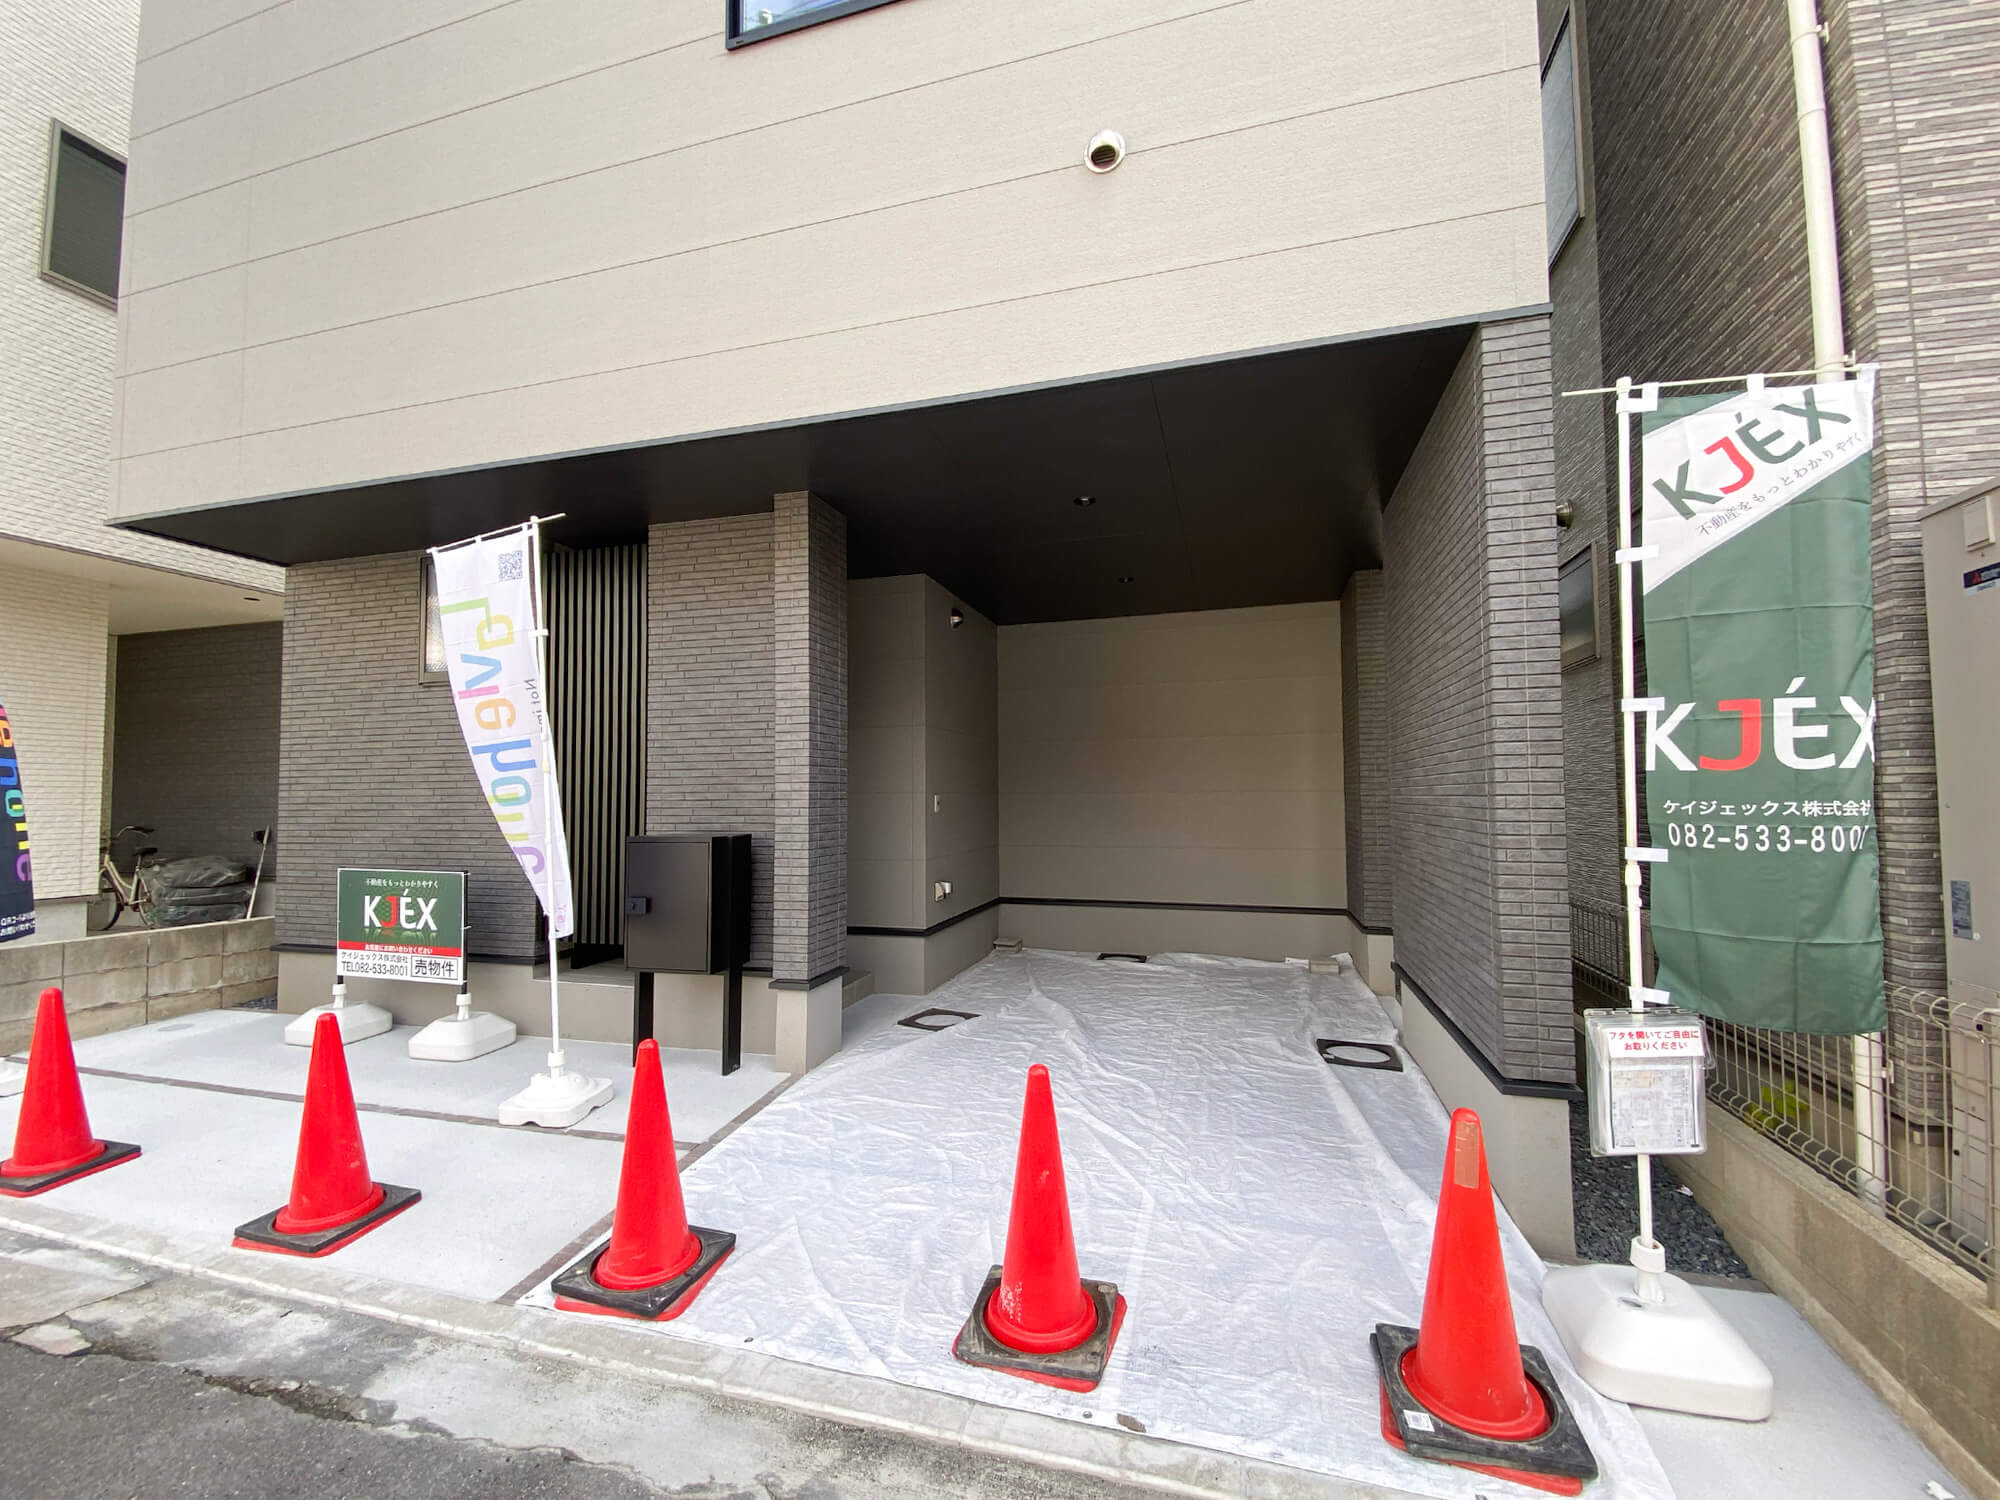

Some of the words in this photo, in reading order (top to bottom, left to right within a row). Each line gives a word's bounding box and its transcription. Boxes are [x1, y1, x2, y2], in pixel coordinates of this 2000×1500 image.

[415, 959, 454, 977] 売物件
[1624, 1041, 1688, 1051] お取りください
